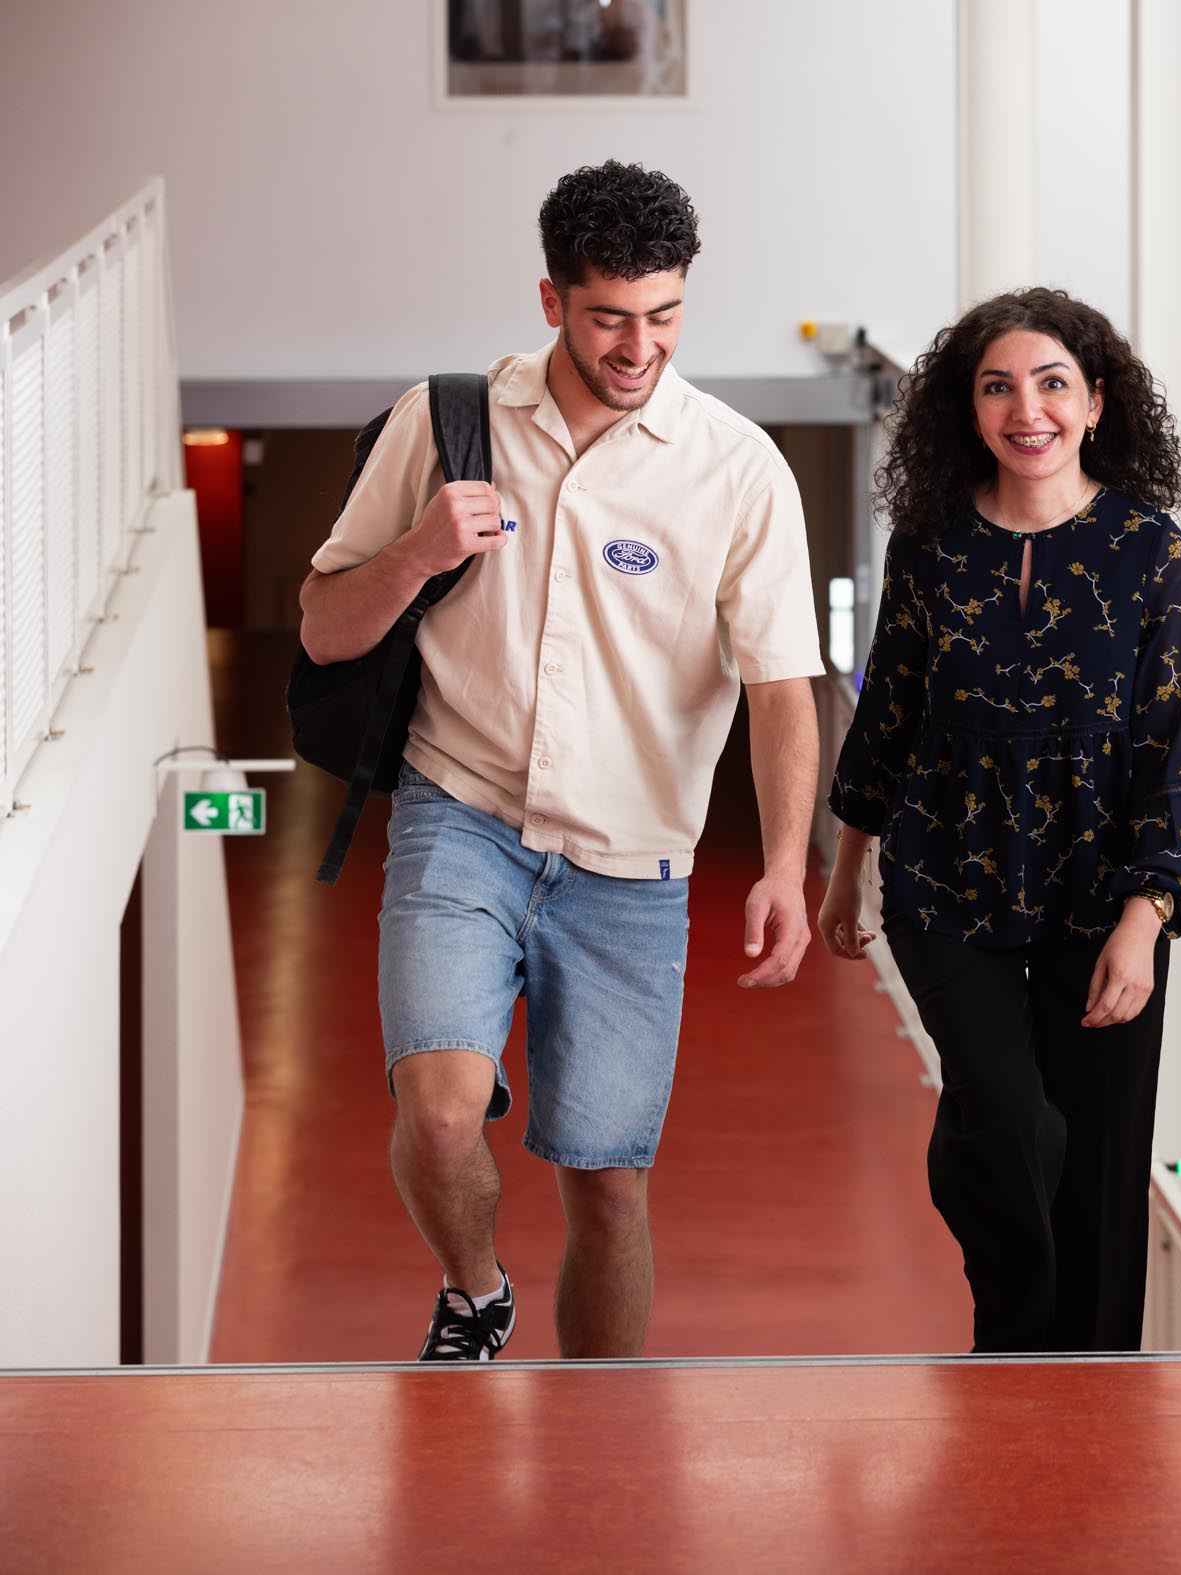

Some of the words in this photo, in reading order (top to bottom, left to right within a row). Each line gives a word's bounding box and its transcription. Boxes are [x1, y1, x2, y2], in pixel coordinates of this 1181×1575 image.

[617, 543, 649, 556] GENUINE
[614, 549, 648, 564] Ford
[618, 562, 641, 572] PARTS
